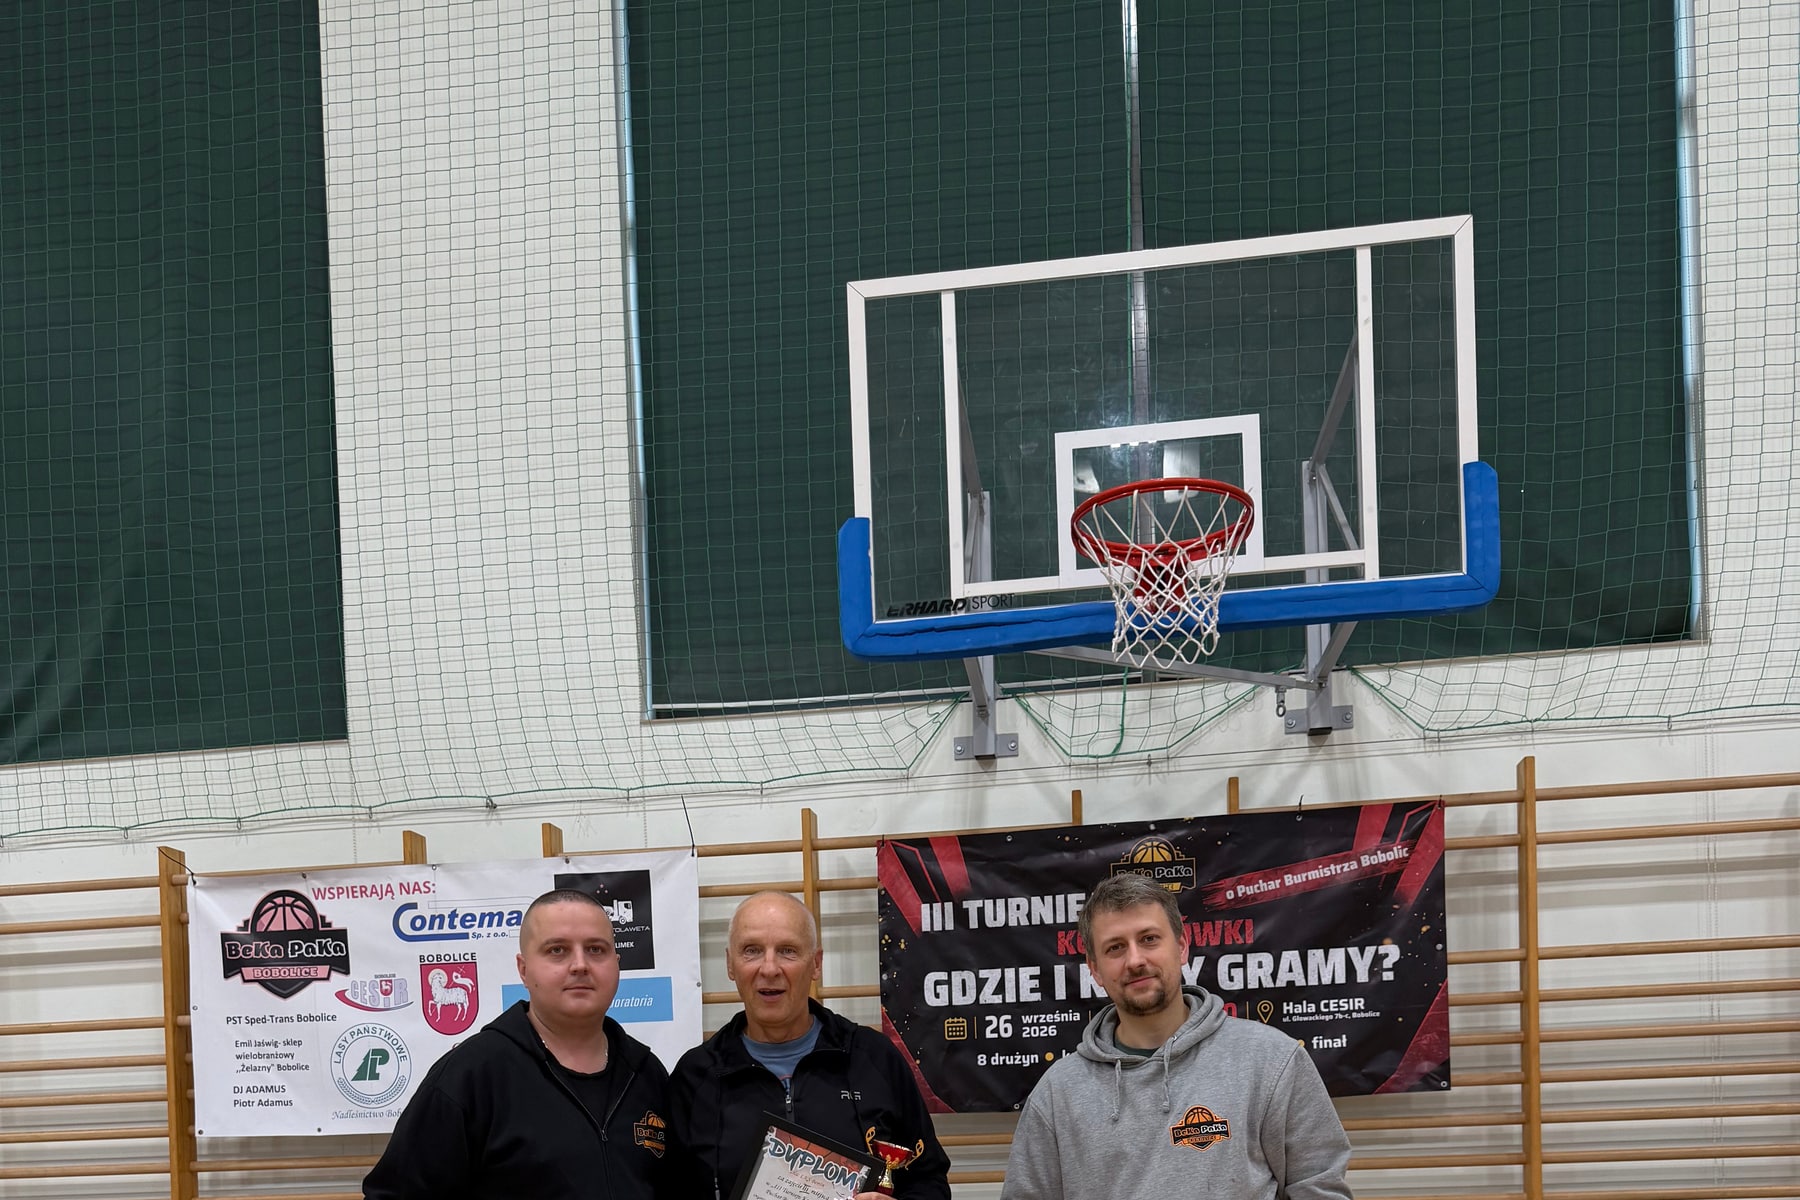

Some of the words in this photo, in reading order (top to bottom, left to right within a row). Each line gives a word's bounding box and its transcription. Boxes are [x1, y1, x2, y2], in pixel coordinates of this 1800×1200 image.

[972, 593, 1015, 610] SPORT
[1155, 865, 1194, 879] PaKa
[1226, 889, 1234, 900] o
[1237, 879, 1281, 897] Puchar
[1284, 860, 1358, 887] Burmistrza
[1360, 846, 1409, 867] Bobolic
[312, 882, 394, 901] WSPIERAJĄ
[399, 880, 436, 896] NAS:
[921, 902, 954, 932] III
[962, 892, 1086, 930] TURNIE
[471, 931, 484, 941] Sp.
[225, 941, 284, 959] BeKa
[288, 938, 347, 958] PaKa
[419, 952, 477, 963] BOBOLICE
[253, 967, 318, 979] BOBOLICE
[1217, 944, 1401, 991] GRAMY?
[924, 966, 1042, 1007] GDZIE
[1053, 964, 1067, 1000] I
[1283, 1000, 1316, 1014] Hala
[1320, 997, 1365, 1012] CESIR
[226, 1016, 242, 1025] PST
[245, 1014, 294, 1026] Sped-Trans
[296, 1013, 337, 1023] Bobolice
[1352, 1011, 1381, 1019] Bobolice
[985, 1015, 1013, 1039] 26
[1021, 1009, 1081, 1024] września
[1022, 1025, 1057, 1038] 2026
[235, 1040, 252, 1048] Emil
[282, 1038, 303, 1048] sklep
[334, 1036, 349, 1064] LASY
[350, 1025, 408, 1062] PAŃSTWOWE
[1312, 1034, 1348, 1049] finał
[235, 1051, 295, 1061] wielobranżowy
[977, 1054, 987, 1066] 8
[991, 1052, 1039, 1067] drużyn
[277, 1063, 310, 1072] Bobolice
[233, 1086, 243, 1094] DJ
[246, 1085, 286, 1094] ADAMUS
[233, 1099, 255, 1108] Piotr
[257, 1098, 293, 1107] Adamus
[768, 1137, 859, 1191] DYPLOM
